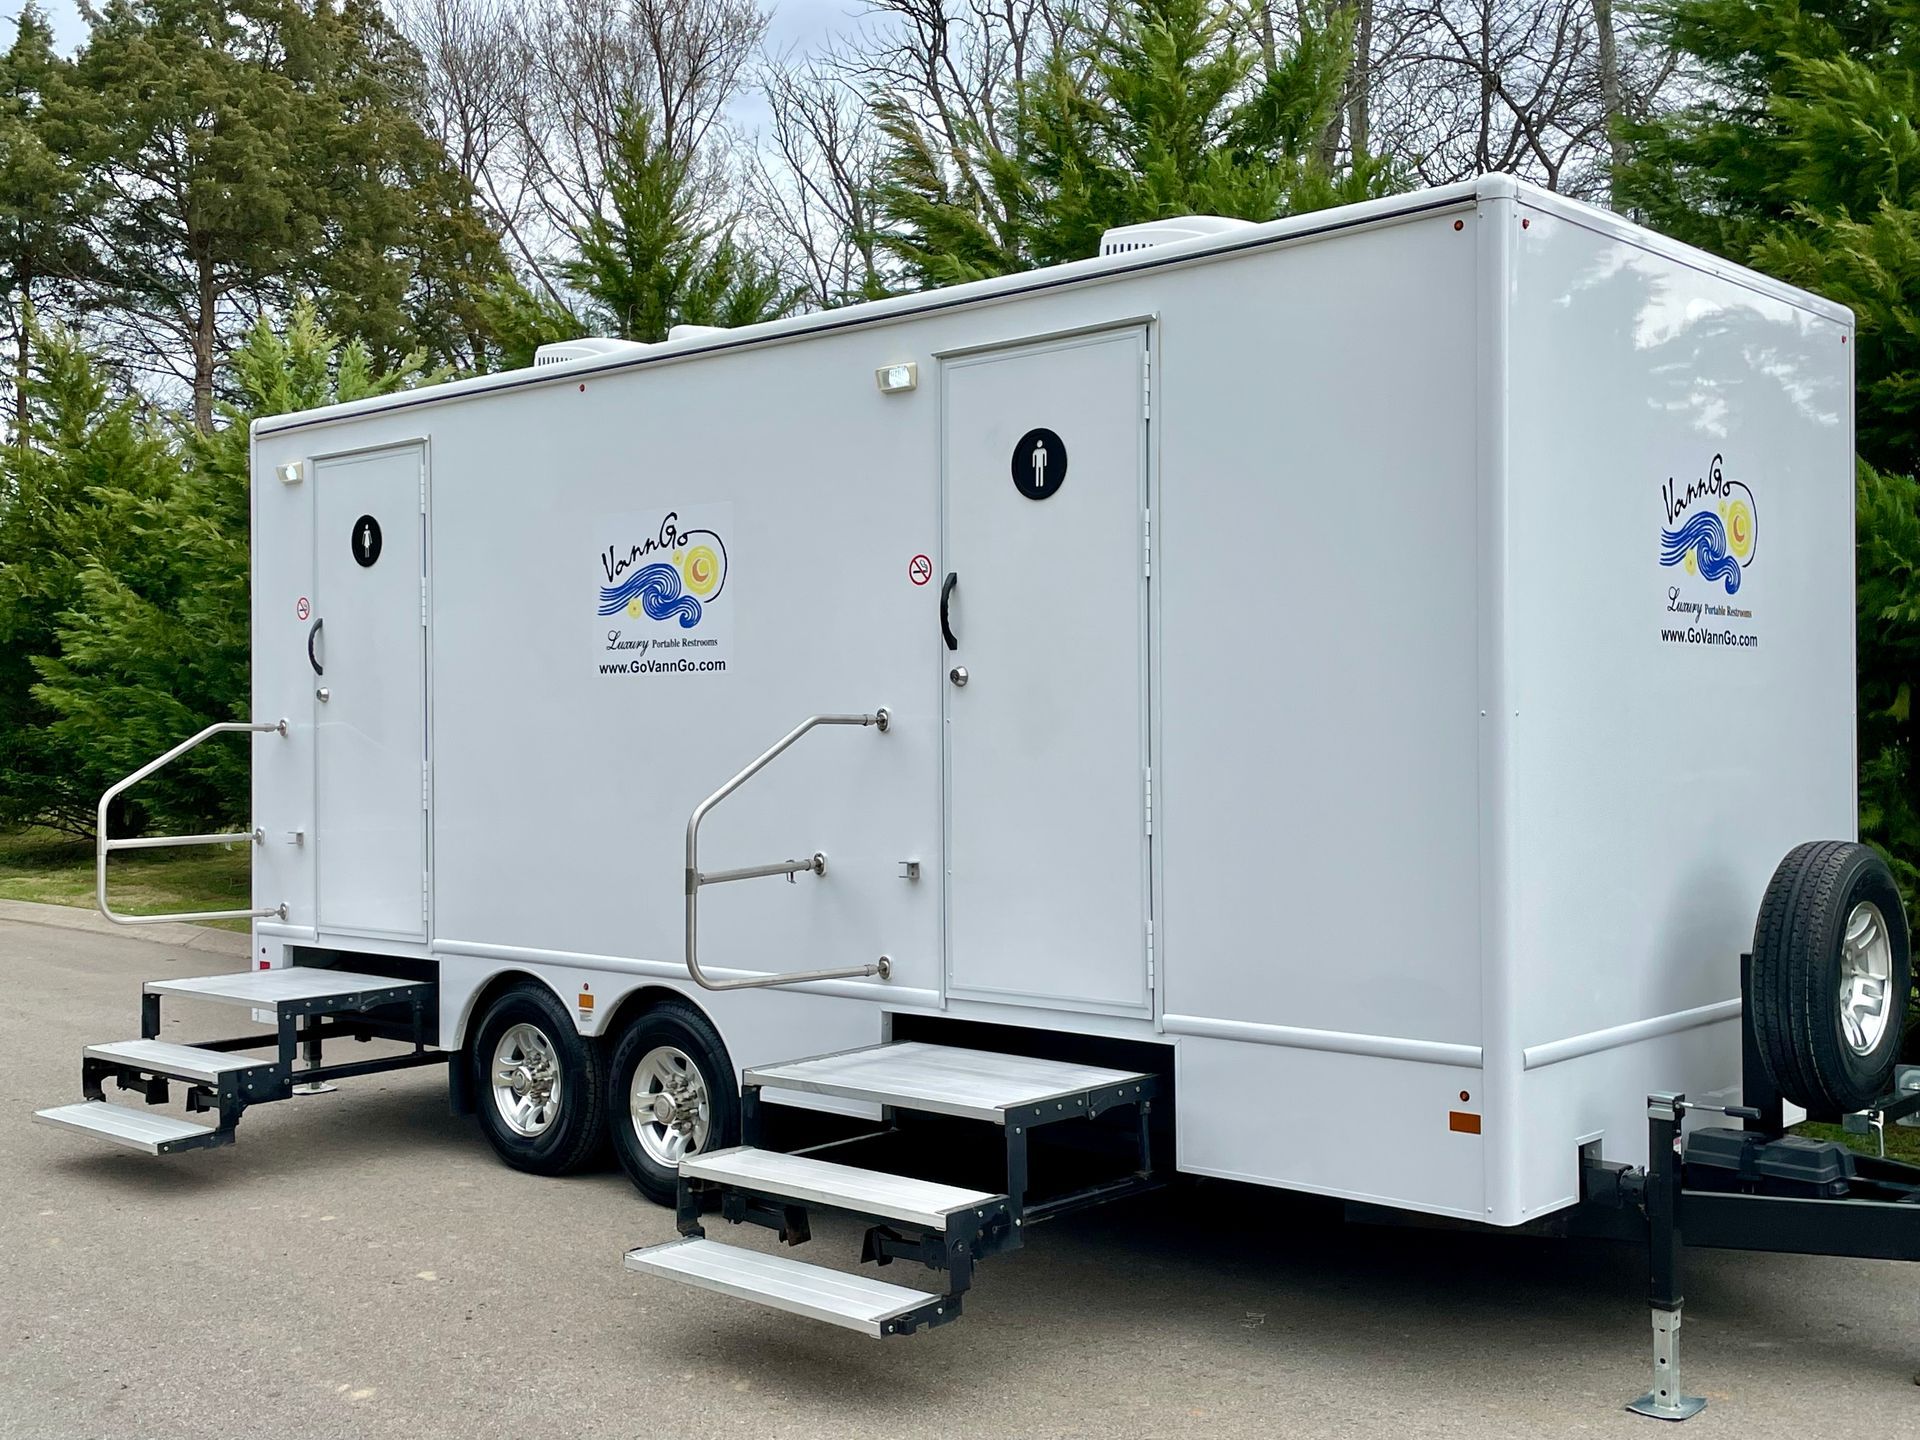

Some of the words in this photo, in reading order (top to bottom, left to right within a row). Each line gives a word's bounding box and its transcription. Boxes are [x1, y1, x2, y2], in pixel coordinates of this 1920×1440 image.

[1662, 453, 1731, 525] VannGo
[601, 512, 690, 583] VannGo
[1667, 586, 1702, 623] Luxury
[1704, 603, 1726, 617] Portable
[606, 630, 649, 656] Luxury
[652, 639, 680, 649] Portable
[682, 637, 718, 648] Restrooms
[1660, 627, 1758, 648] www.GoVannGo.com
[599, 658, 726, 674] www.GoVannGo.com
